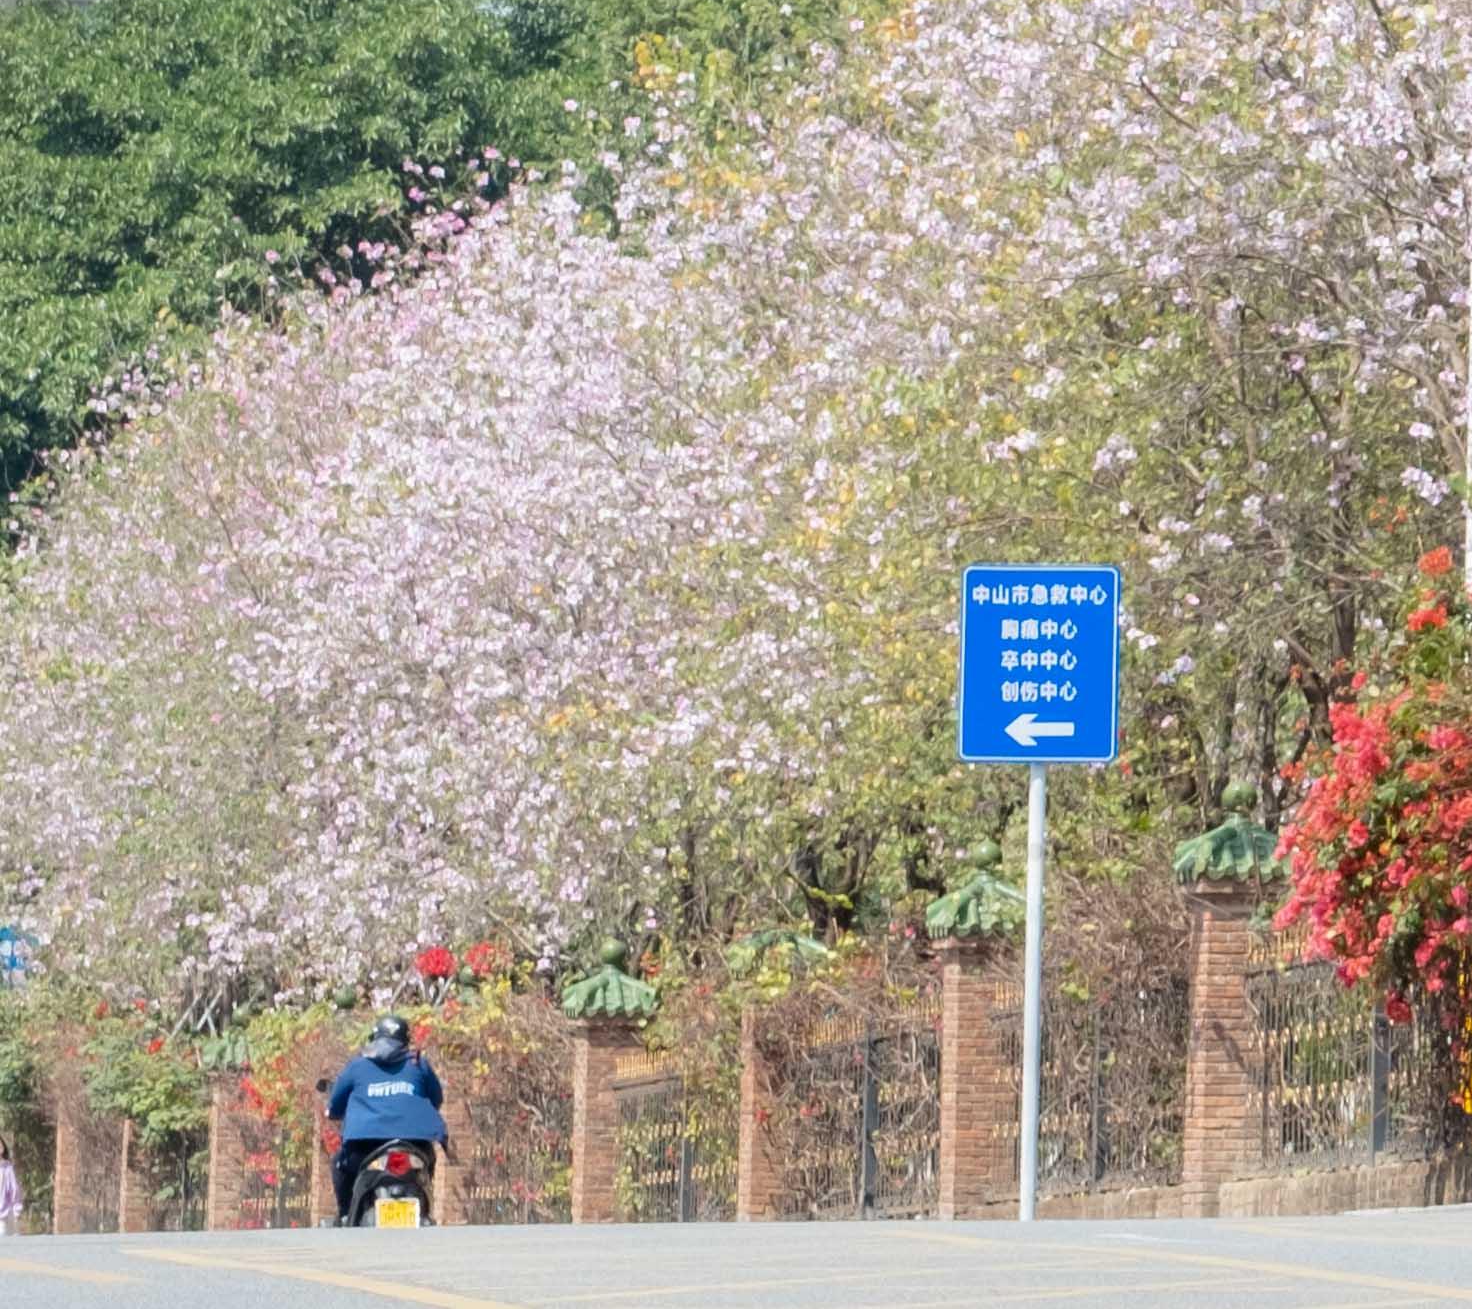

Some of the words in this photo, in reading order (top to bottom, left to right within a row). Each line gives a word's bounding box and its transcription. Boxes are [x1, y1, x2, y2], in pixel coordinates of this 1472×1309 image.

[972, 583, 1108, 605] 中山市急救中心
[1001, 618, 1078, 640] 胸痛中心
[1000, 649, 1078, 671] 卒中中心
[1000, 680, 1078, 702] 创伤中心
